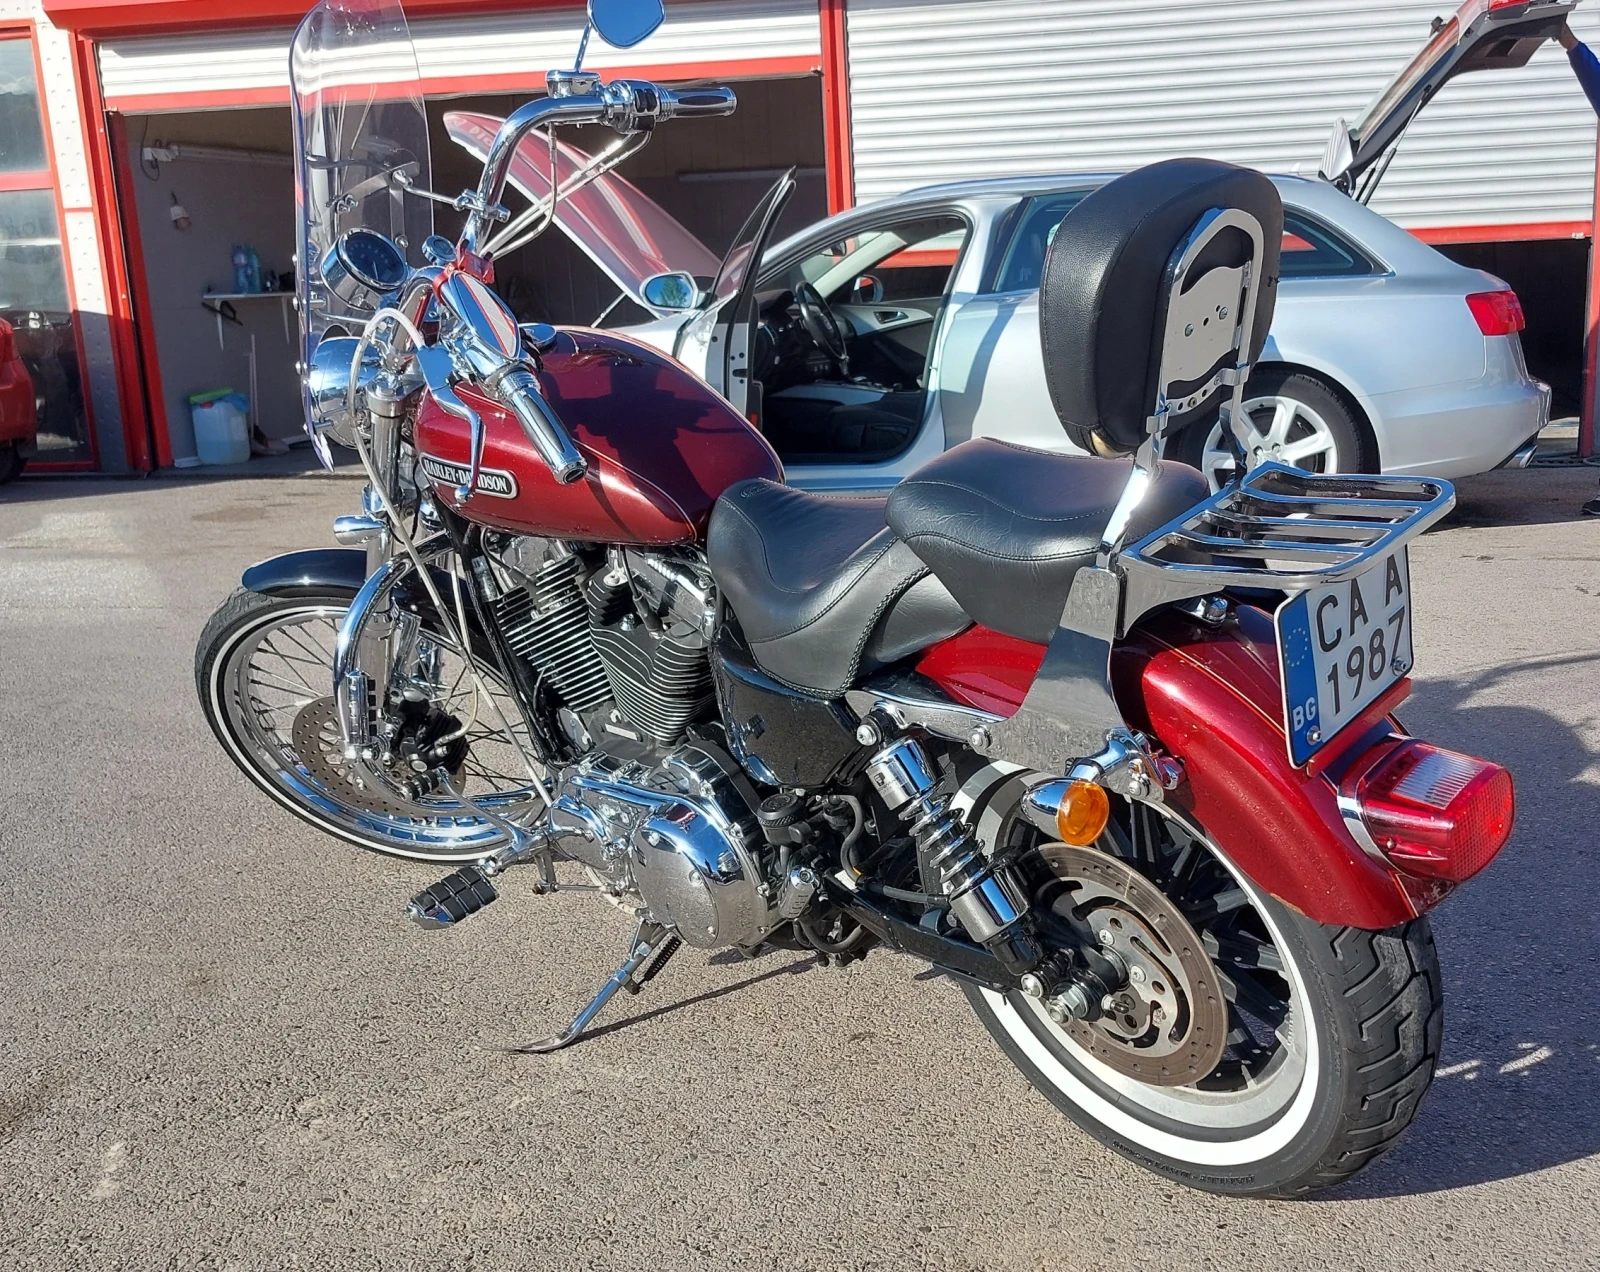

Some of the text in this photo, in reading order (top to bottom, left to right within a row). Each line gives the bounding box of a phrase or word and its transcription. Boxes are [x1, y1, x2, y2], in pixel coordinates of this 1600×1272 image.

[1316, 553, 1403, 653] CA A
[1327, 606, 1405, 716] 1987
[1292, 697, 1317, 732] BG
